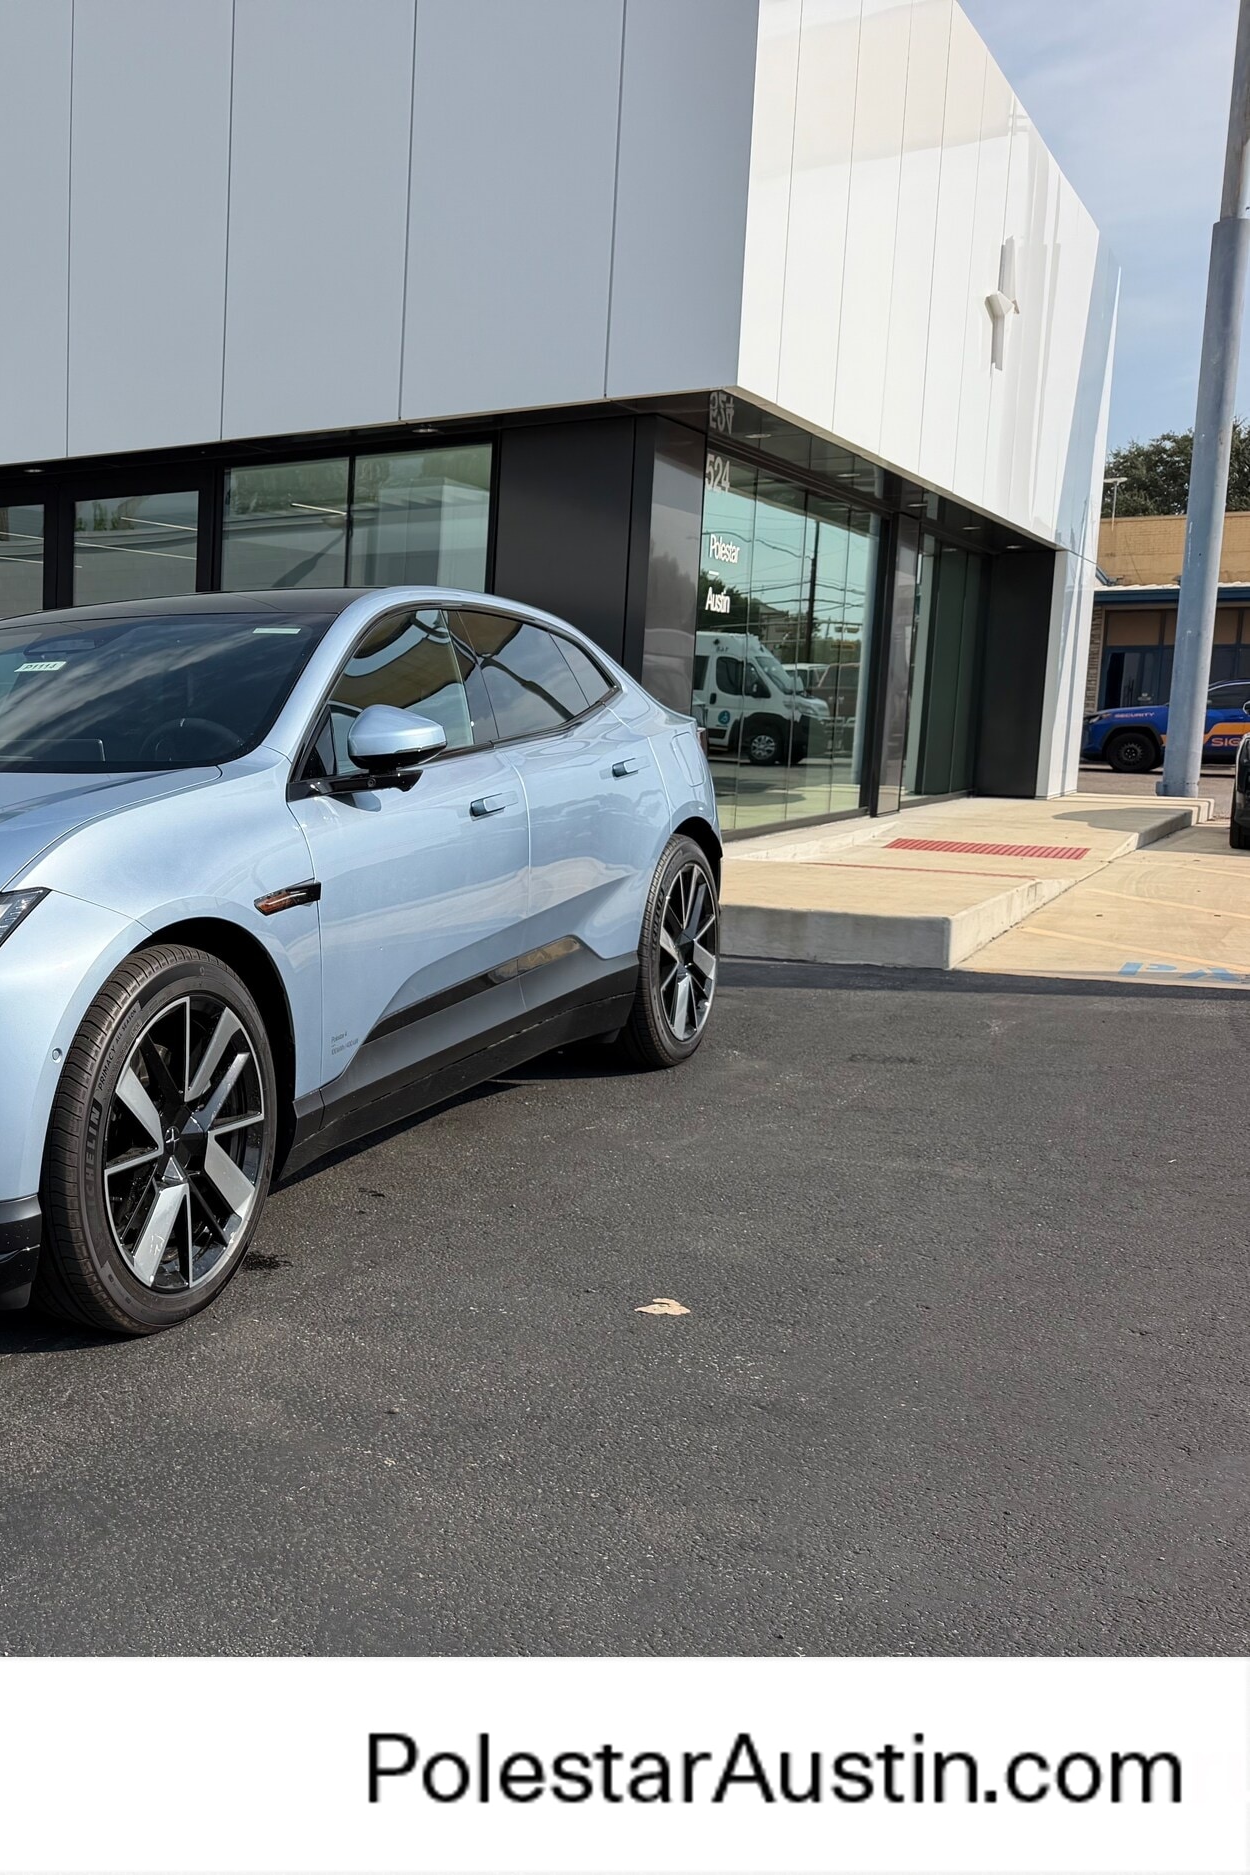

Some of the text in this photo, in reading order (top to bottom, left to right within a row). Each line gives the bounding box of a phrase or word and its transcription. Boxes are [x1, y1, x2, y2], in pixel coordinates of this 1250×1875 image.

[705, 453, 730, 494] 524
[709, 533, 740, 564] Polestar
[705, 586, 731, 614] Austin
[97, 1046, 115, 1091] PRIMACY
[121, 1009, 137, 1031] SEASON
